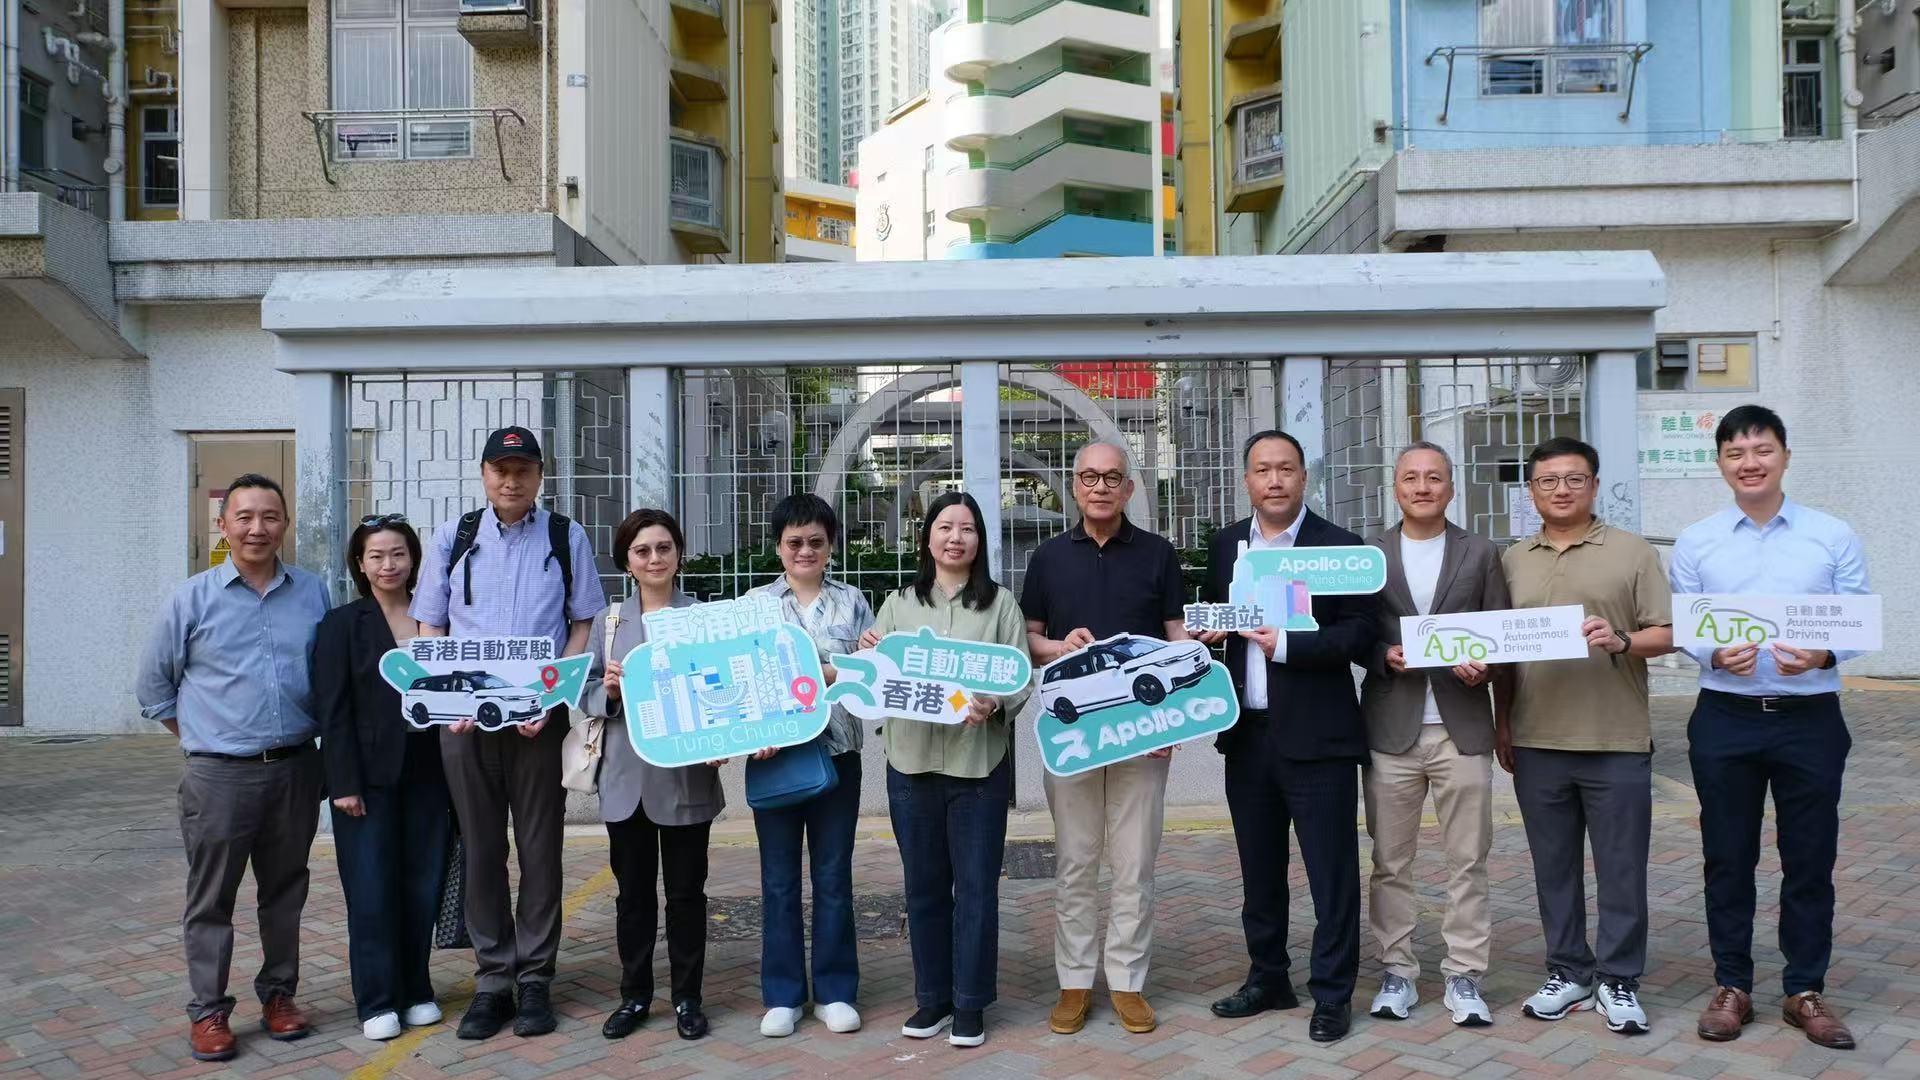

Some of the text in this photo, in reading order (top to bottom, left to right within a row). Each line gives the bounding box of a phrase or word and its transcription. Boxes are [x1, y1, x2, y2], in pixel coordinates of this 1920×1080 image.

[1278, 555, 1373, 574] Apollo Go
[646, 596, 785, 645] 東涌站
[1184, 604, 1264, 630] 東涌站
[1786, 605, 1844, 617] 自動駕駛
[1502, 617, 1553, 631] 自動駕駛
[1786, 617, 1864, 628] Autonomous
[1503, 629, 1570, 643] Autonomous
[1786, 629, 1830, 642] Driving
[411, 638, 553, 662] 香港自動駕駛
[1504, 642, 1543, 654] Driving
[901, 644, 1020, 686] 自動駕駛
[881, 678, 945, 715] 香港
[1098, 696, 1229, 751] Apollo Go
[670, 717, 801, 755] Tung Chung
